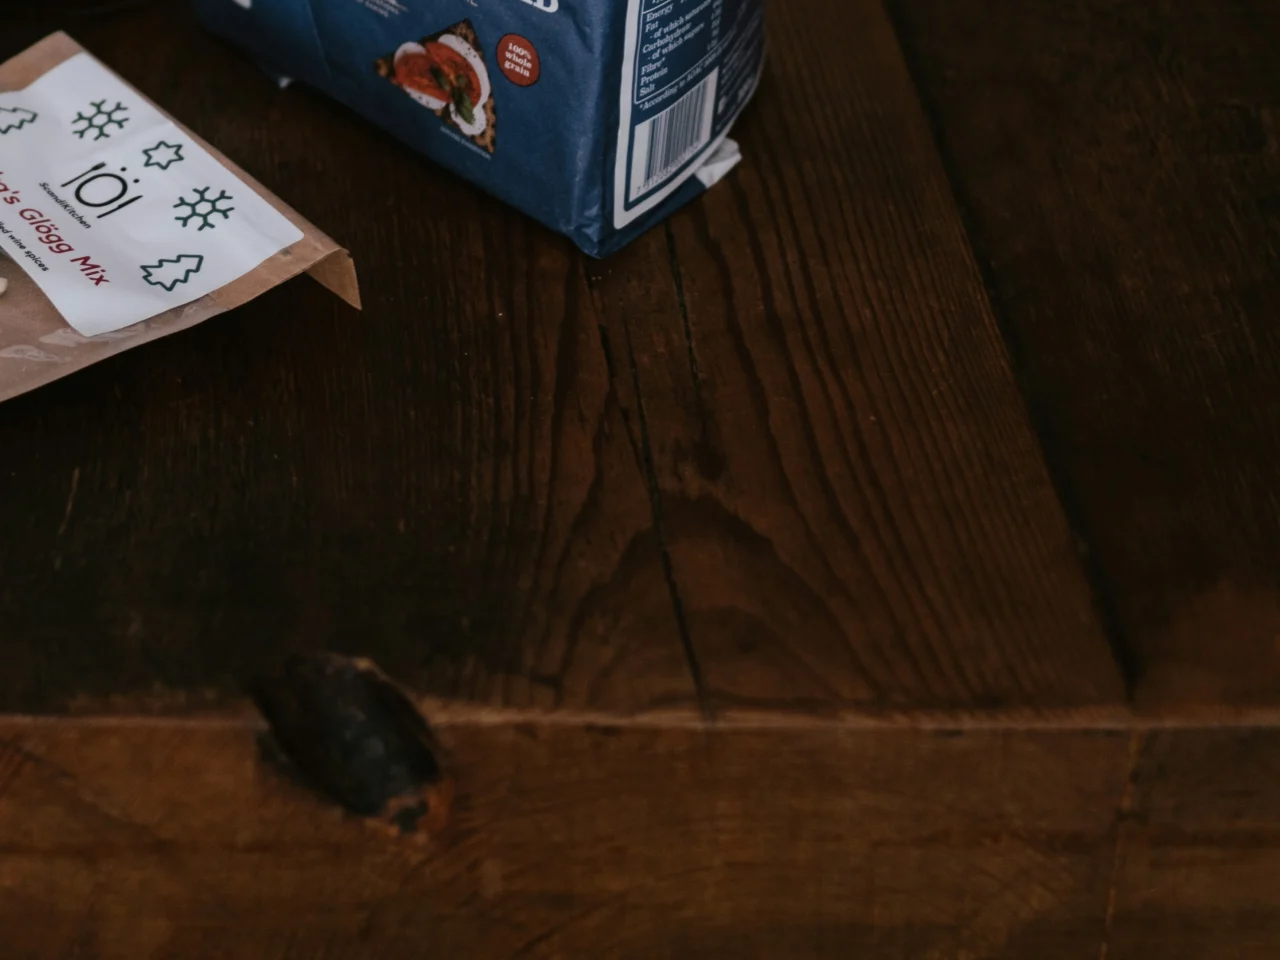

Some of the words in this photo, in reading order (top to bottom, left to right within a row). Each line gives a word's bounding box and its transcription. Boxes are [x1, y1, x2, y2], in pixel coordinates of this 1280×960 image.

[646, 3, 674, 22] Energy
[645, 21, 659, 33] Fat
[505, 50, 533, 69] whole
[507, 42, 532, 60] 100%
[504, 59, 531, 78] grain
[640, 67, 669, 86] Protein
[639, 82, 656, 97] Salt
[38, 182, 92, 229] ScandiKitchen
[8, 234, 26, 250] wine
[24, 249, 50, 272] spices
[19, 207, 75, 254] Glögg
[70, 255, 111, 286] Mix
